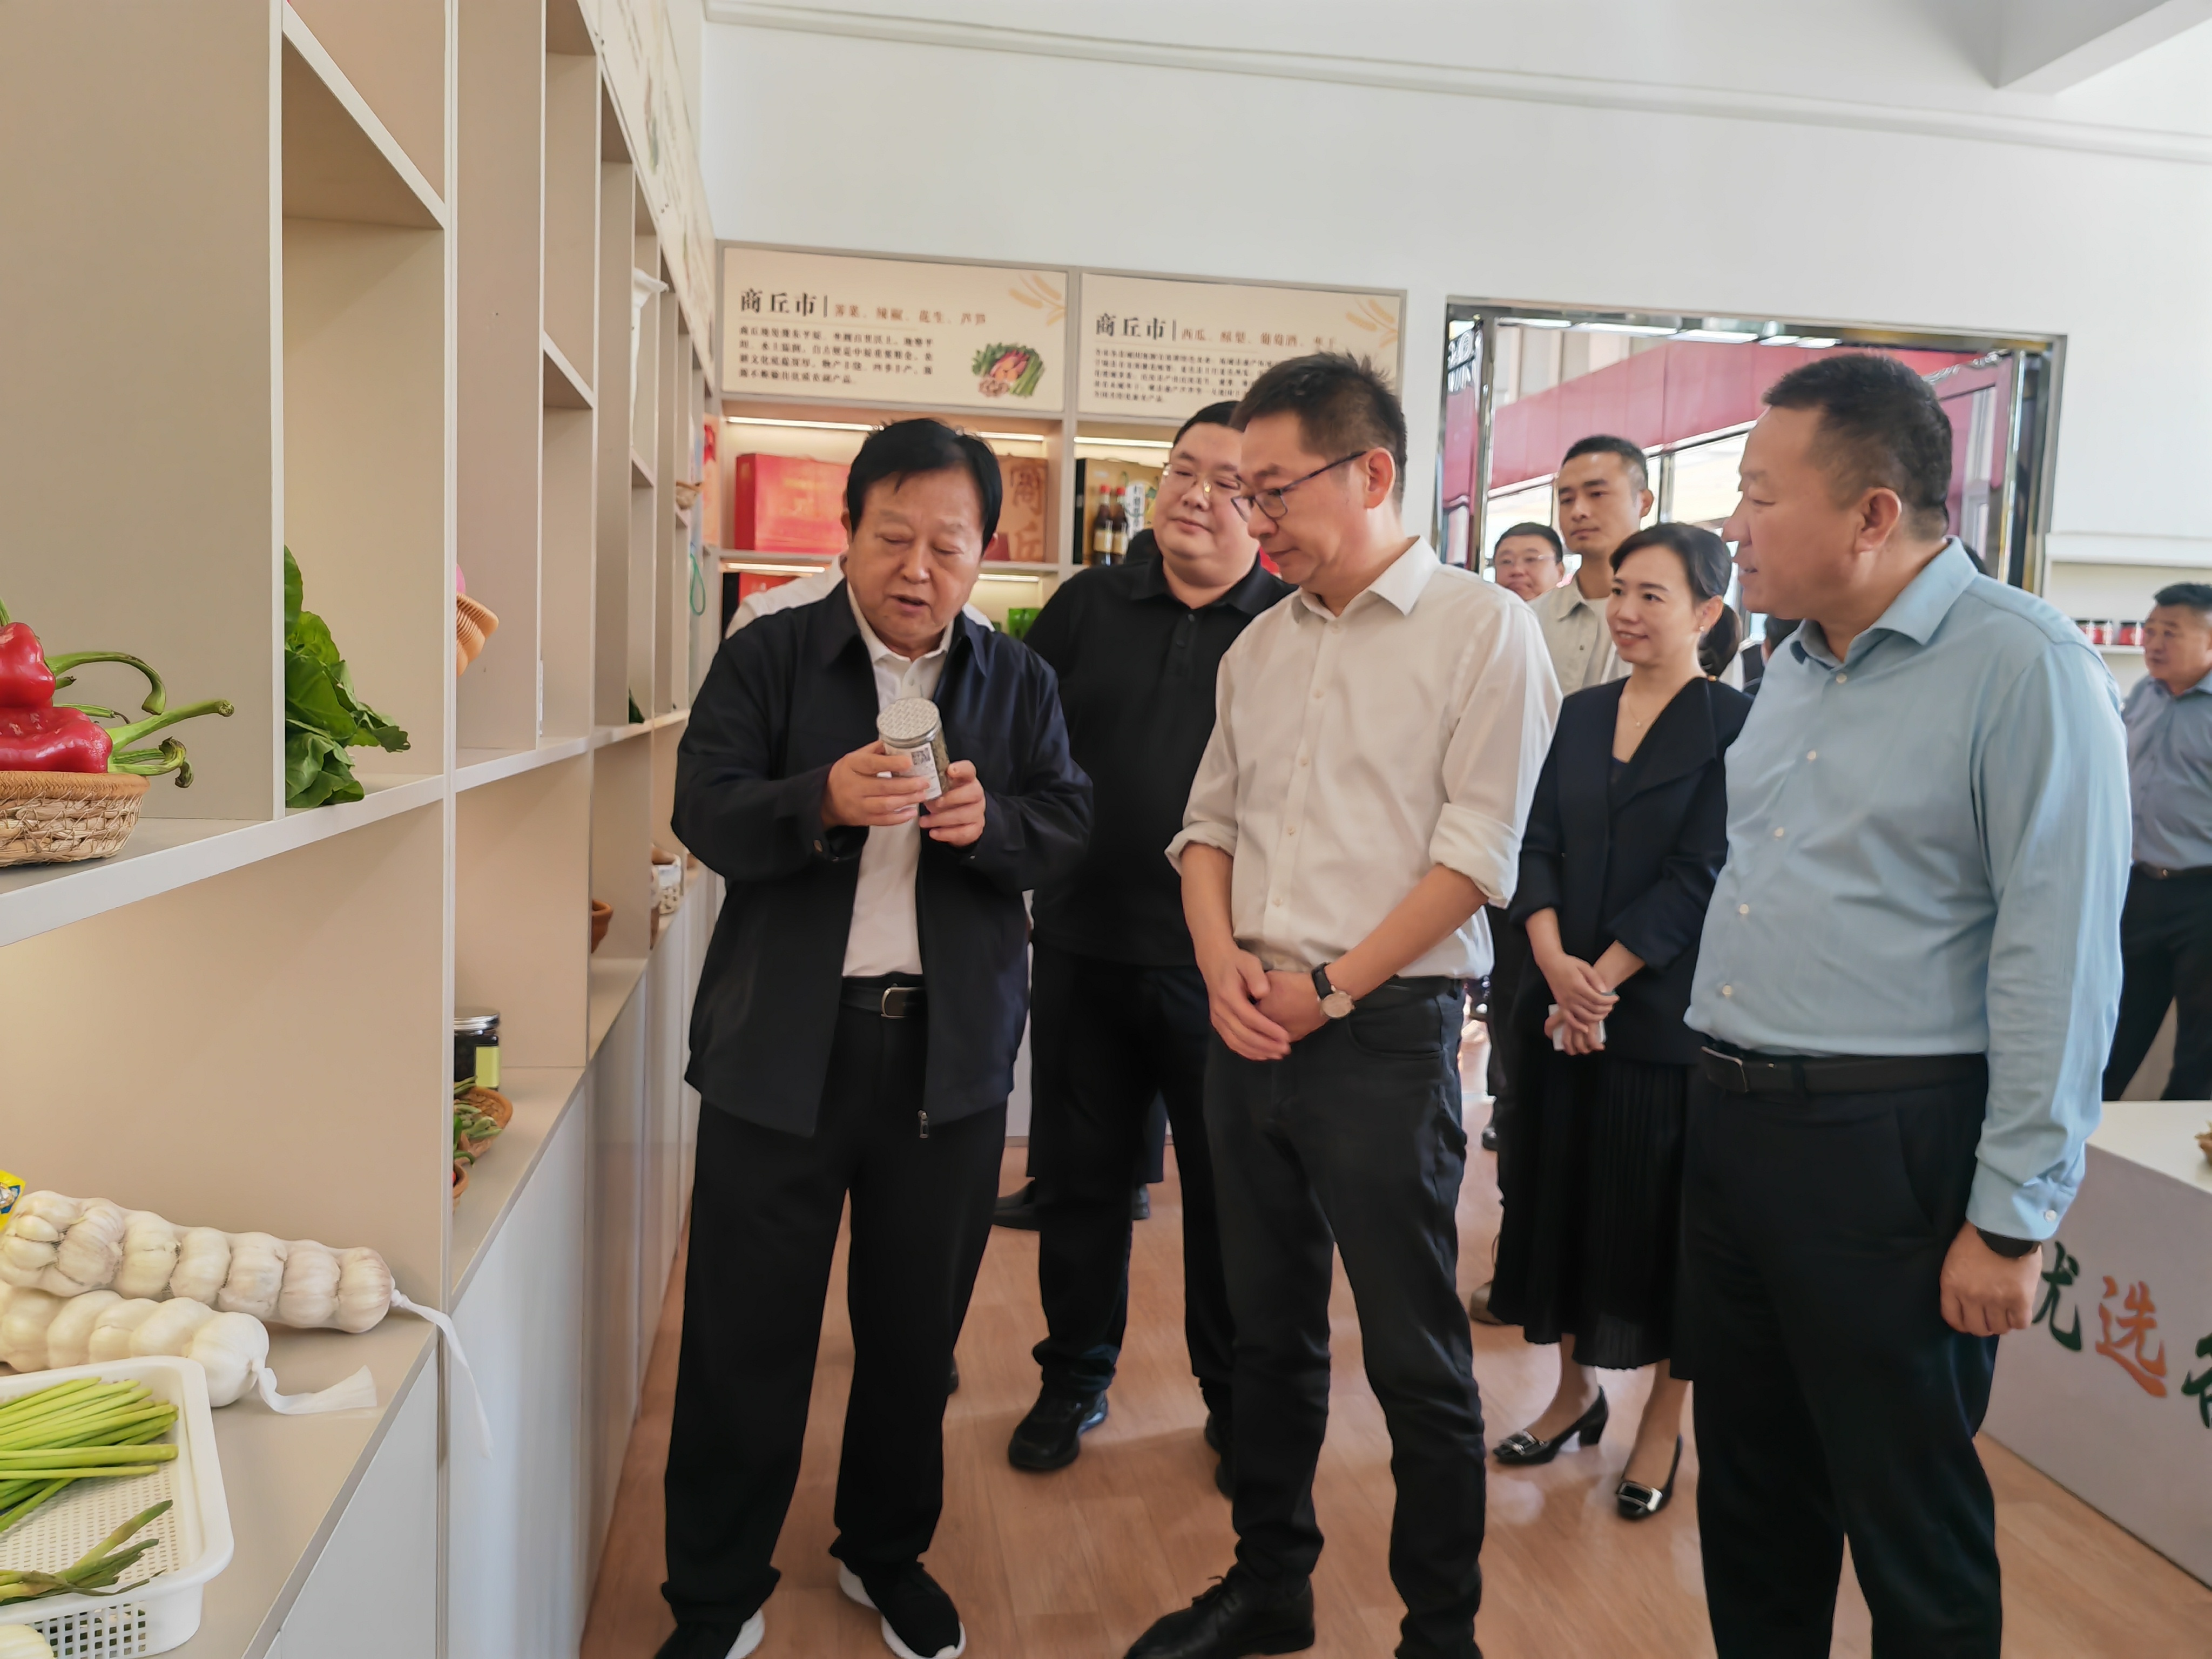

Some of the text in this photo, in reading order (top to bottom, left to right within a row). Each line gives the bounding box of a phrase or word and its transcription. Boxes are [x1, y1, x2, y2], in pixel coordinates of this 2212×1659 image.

[740, 287, 817, 317] 商丘市
[1095, 312, 1166, 341] 商丘市
